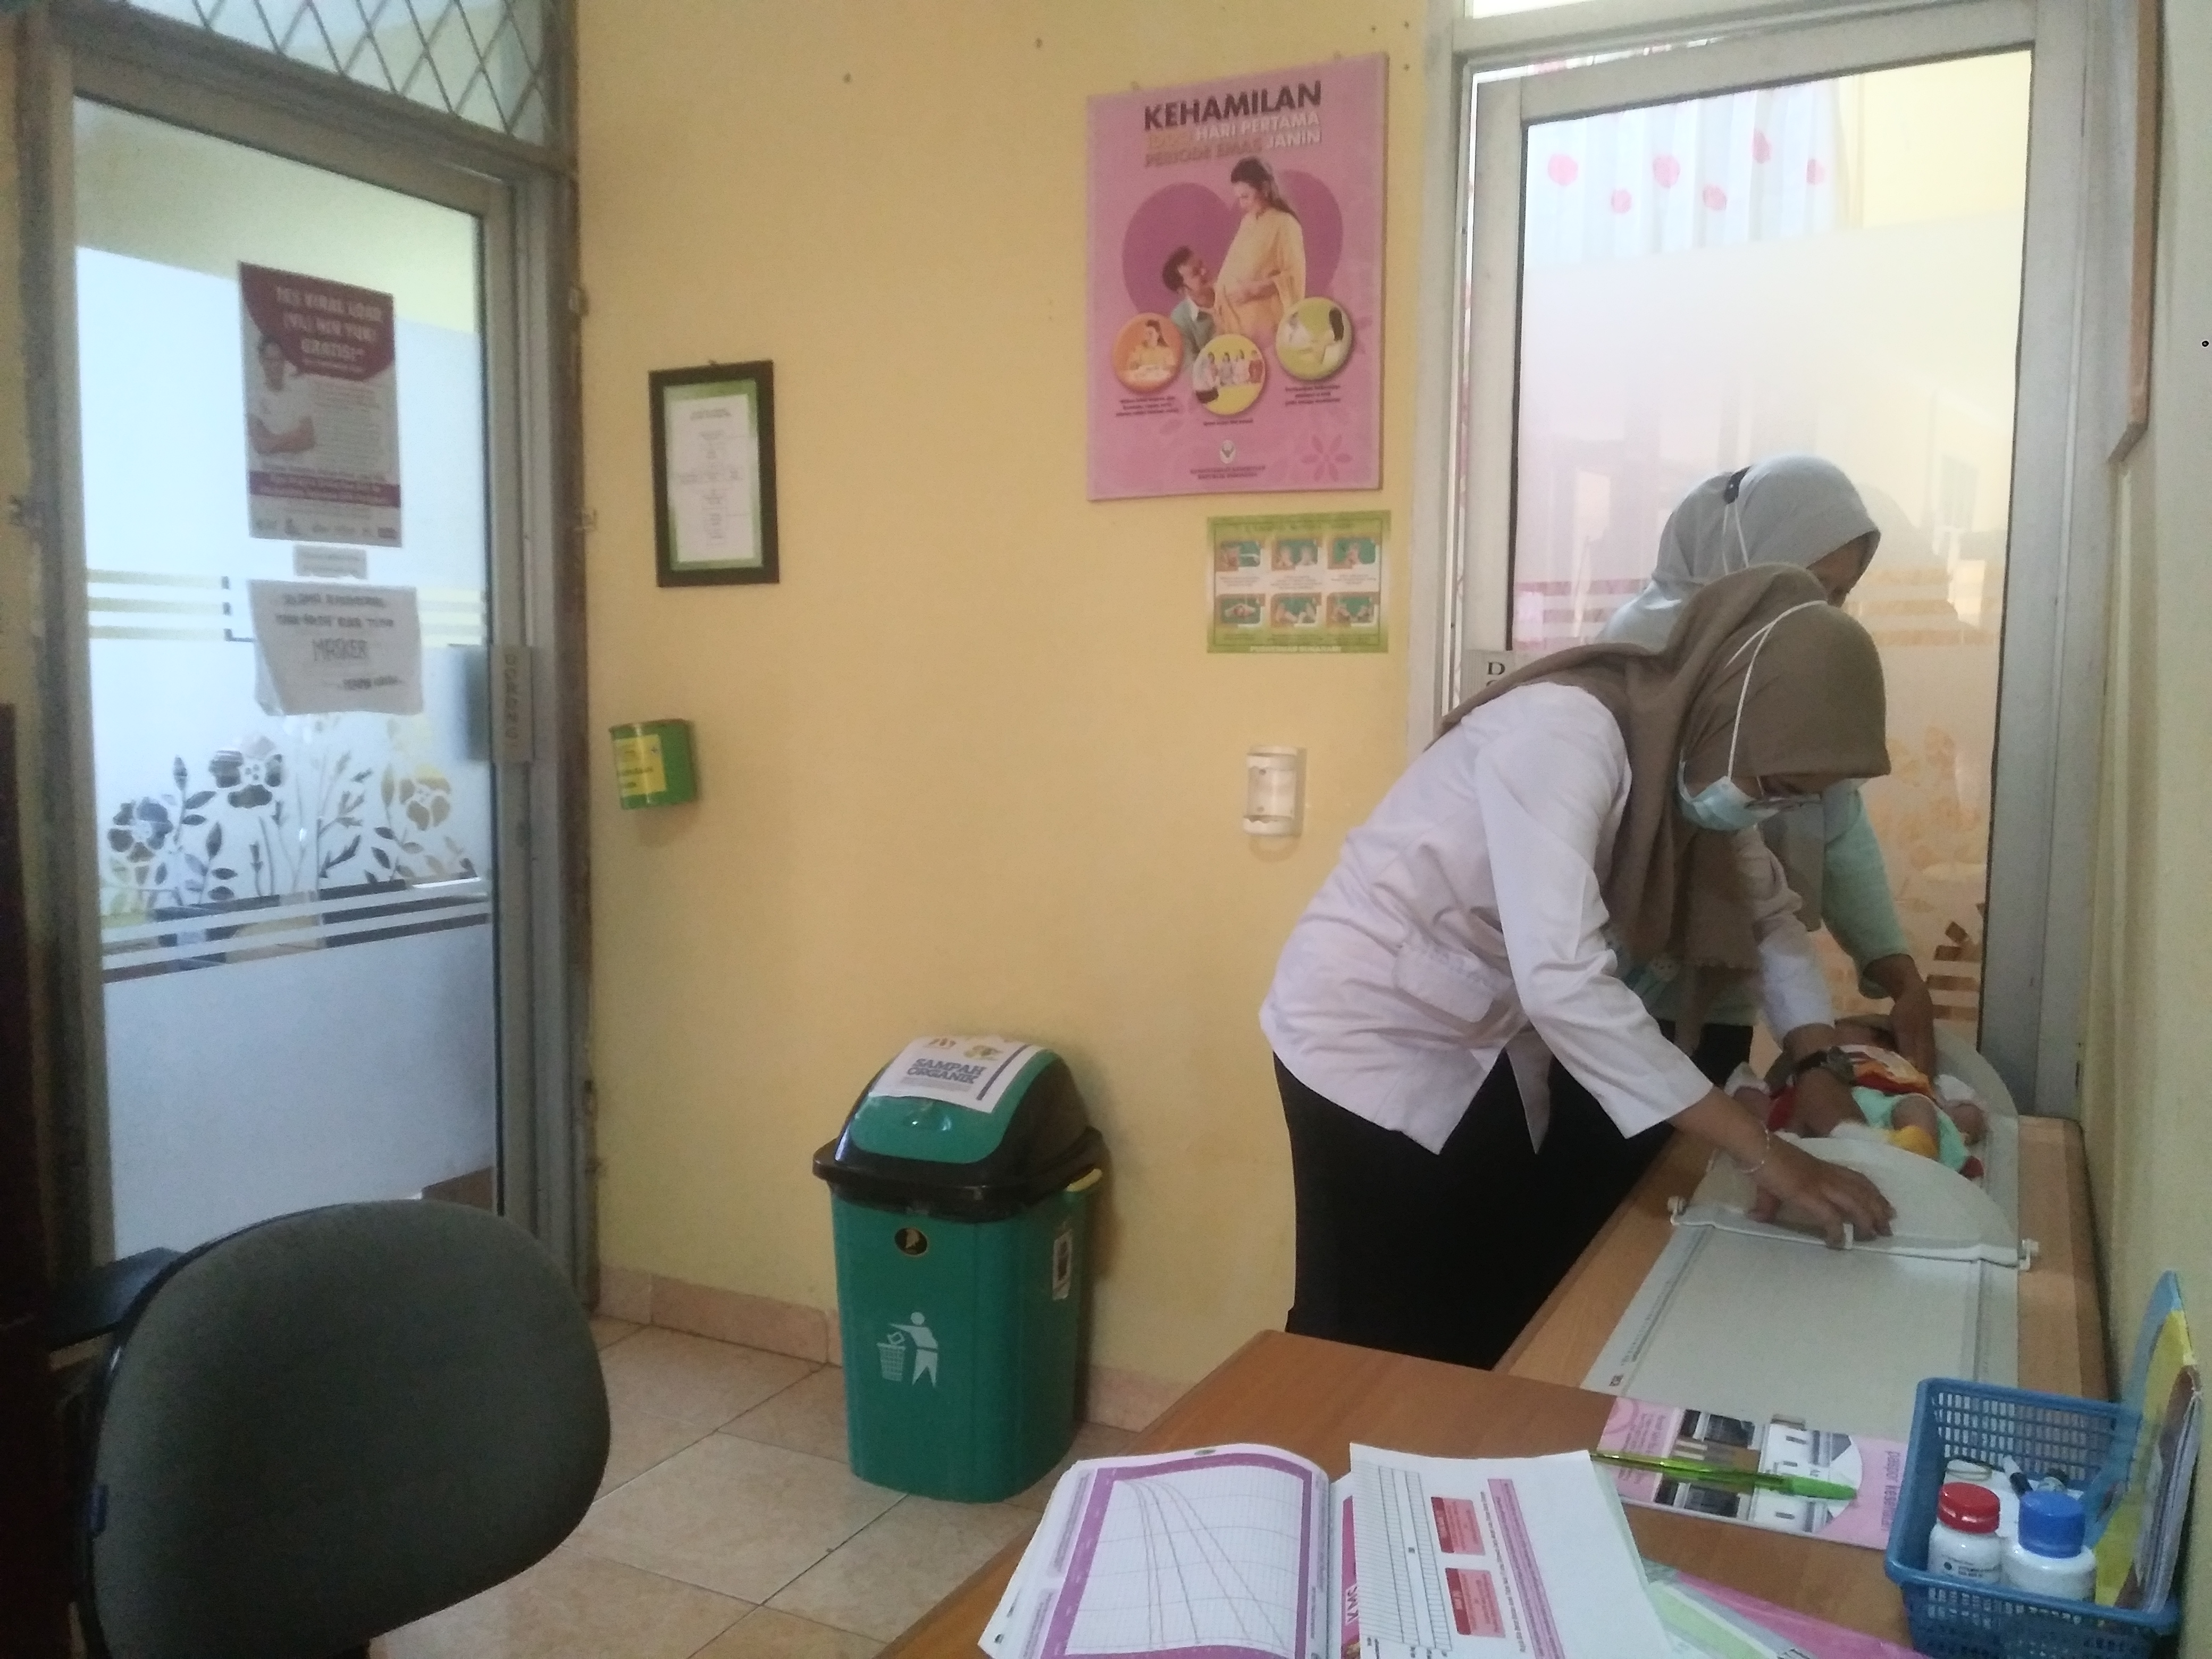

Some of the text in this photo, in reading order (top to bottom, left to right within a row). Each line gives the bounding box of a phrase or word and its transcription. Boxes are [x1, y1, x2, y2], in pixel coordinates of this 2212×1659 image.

[1144, 80, 1322, 131] KEHAMILAN
[1196, 111, 1320, 141] HARI PERTAMA
[1265, 131, 1322, 149] JANIN
[907, 1067, 979, 1084] ORGANIK
[911, 1058, 987, 1076] SAMPAH
